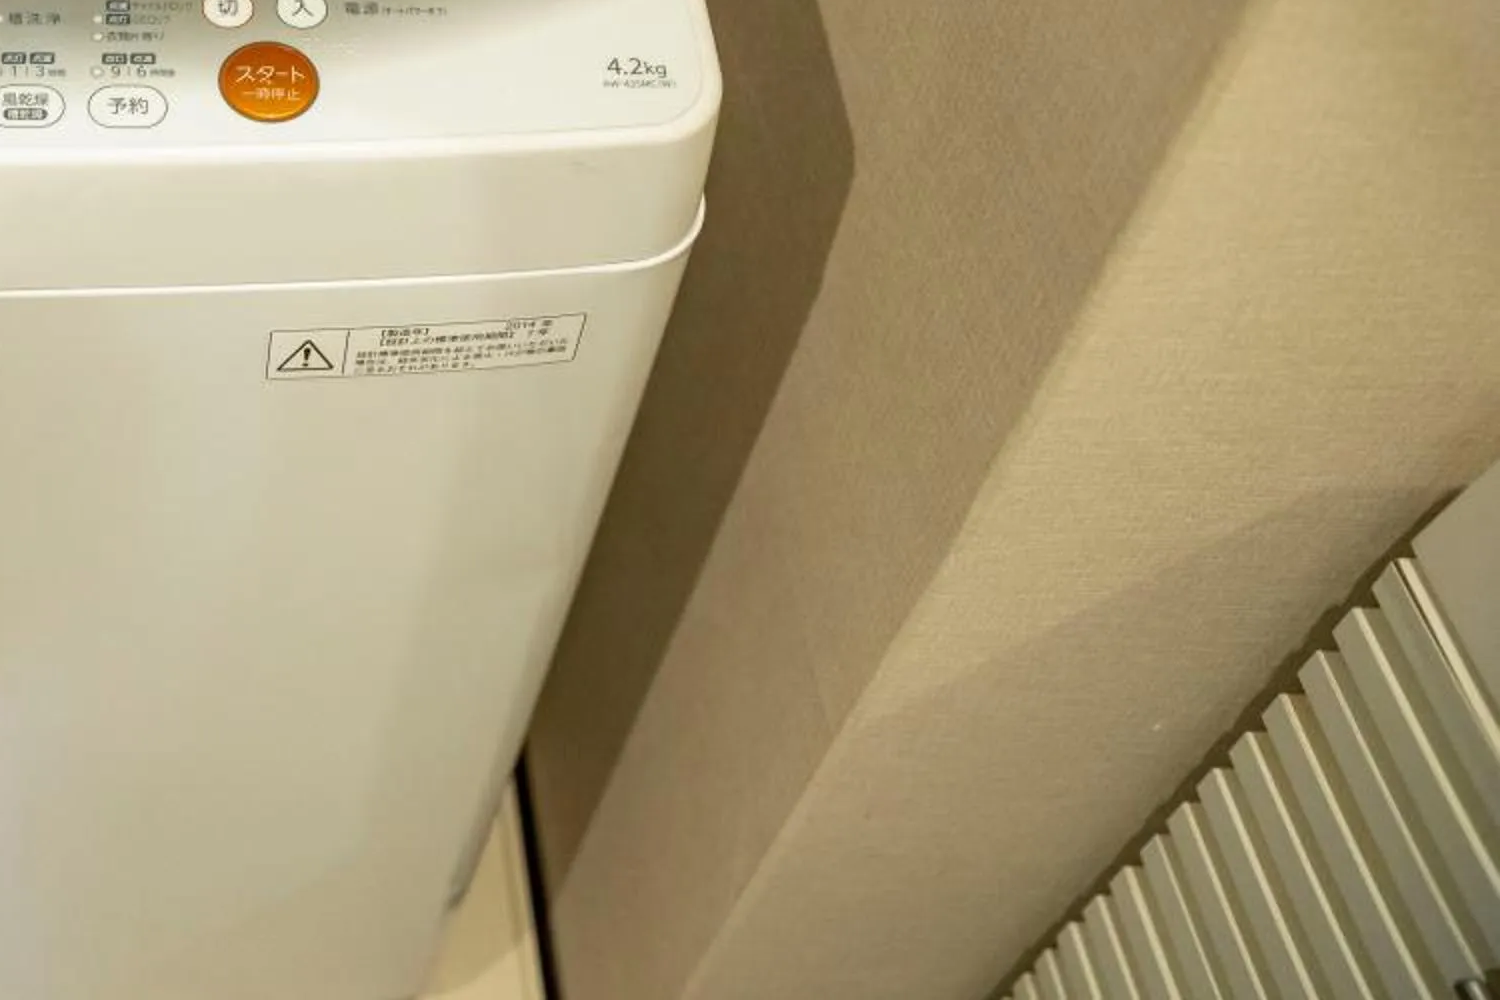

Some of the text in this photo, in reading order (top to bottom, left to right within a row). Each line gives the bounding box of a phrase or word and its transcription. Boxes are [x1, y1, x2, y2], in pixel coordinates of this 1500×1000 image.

[217, 0, 239, 17] 切
[293, 0, 315, 17] 入
[235, 64, 306, 85] スタート
[607, 57, 667, 79] 4.2kg
[107, 98, 149, 116] 予約
